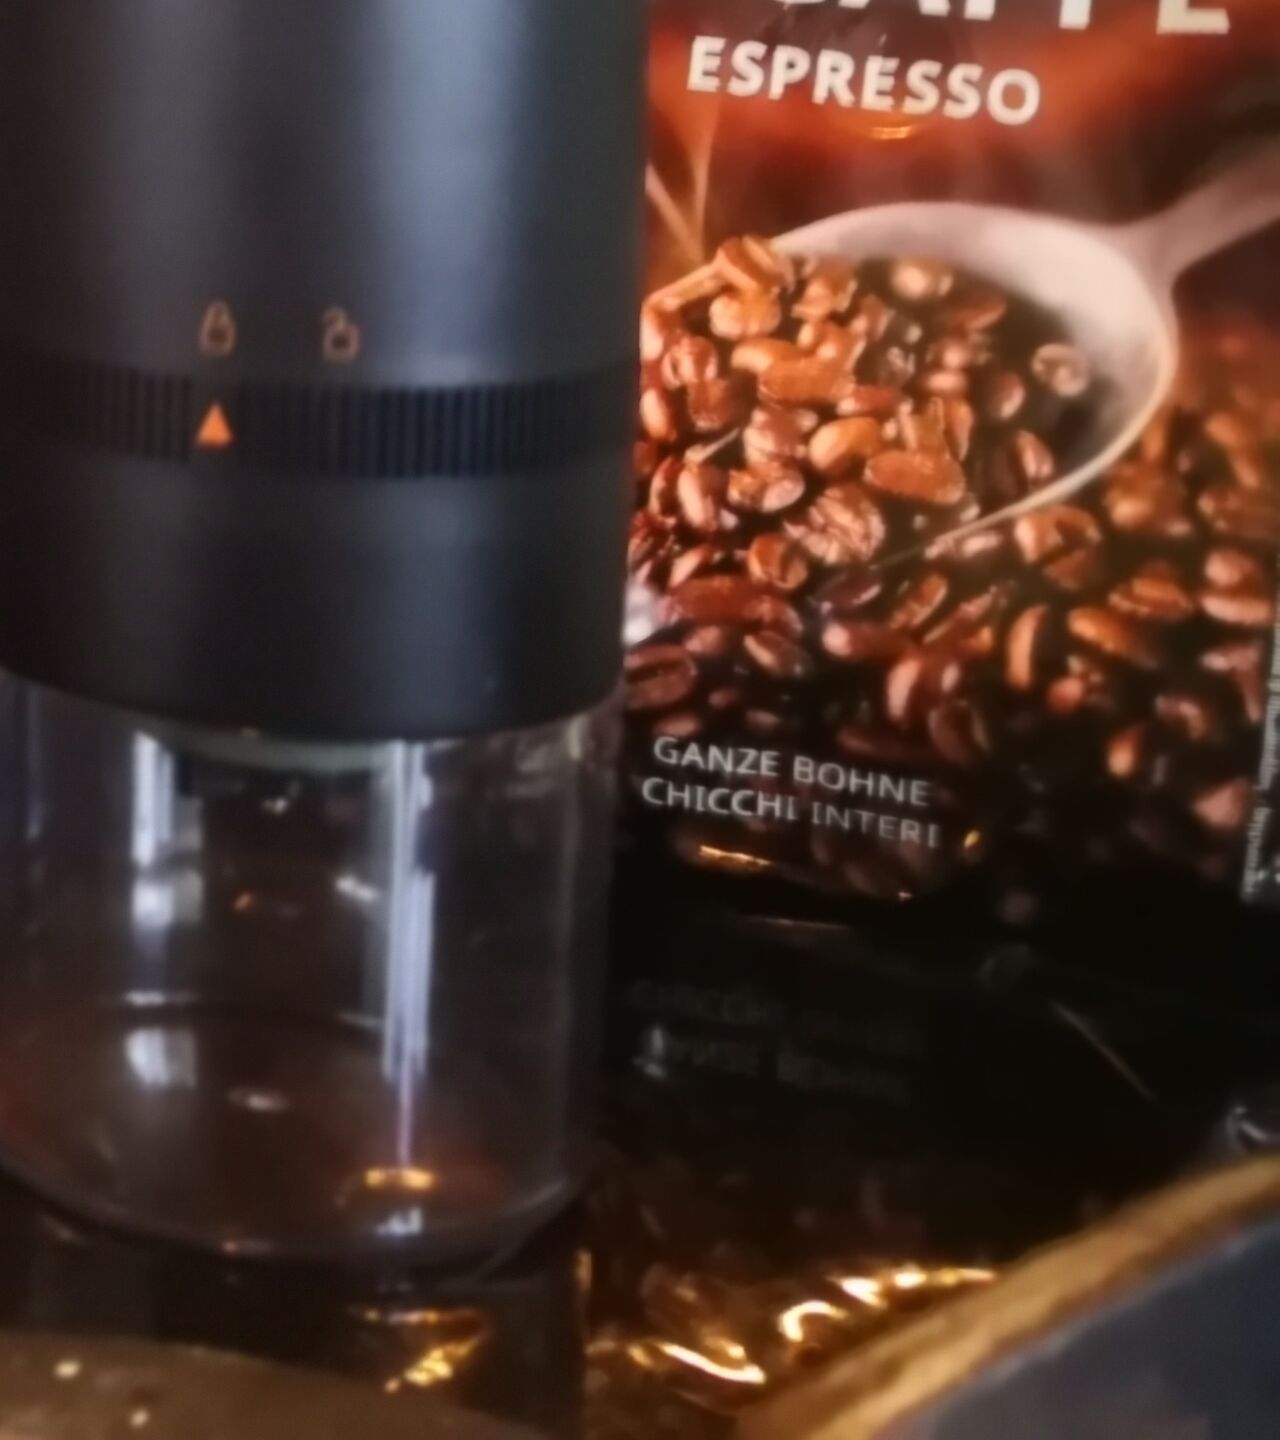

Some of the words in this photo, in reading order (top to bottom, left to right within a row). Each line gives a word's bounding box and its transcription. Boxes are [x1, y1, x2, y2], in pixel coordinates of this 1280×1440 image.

[687, 35, 1041, 126] ESPRESSO
[653, 736, 782, 777] GANZE
[793, 755, 932, 807] BOHNE
[641, 777, 799, 821] CHICCHI
[811, 801, 941, 849] INTERI
